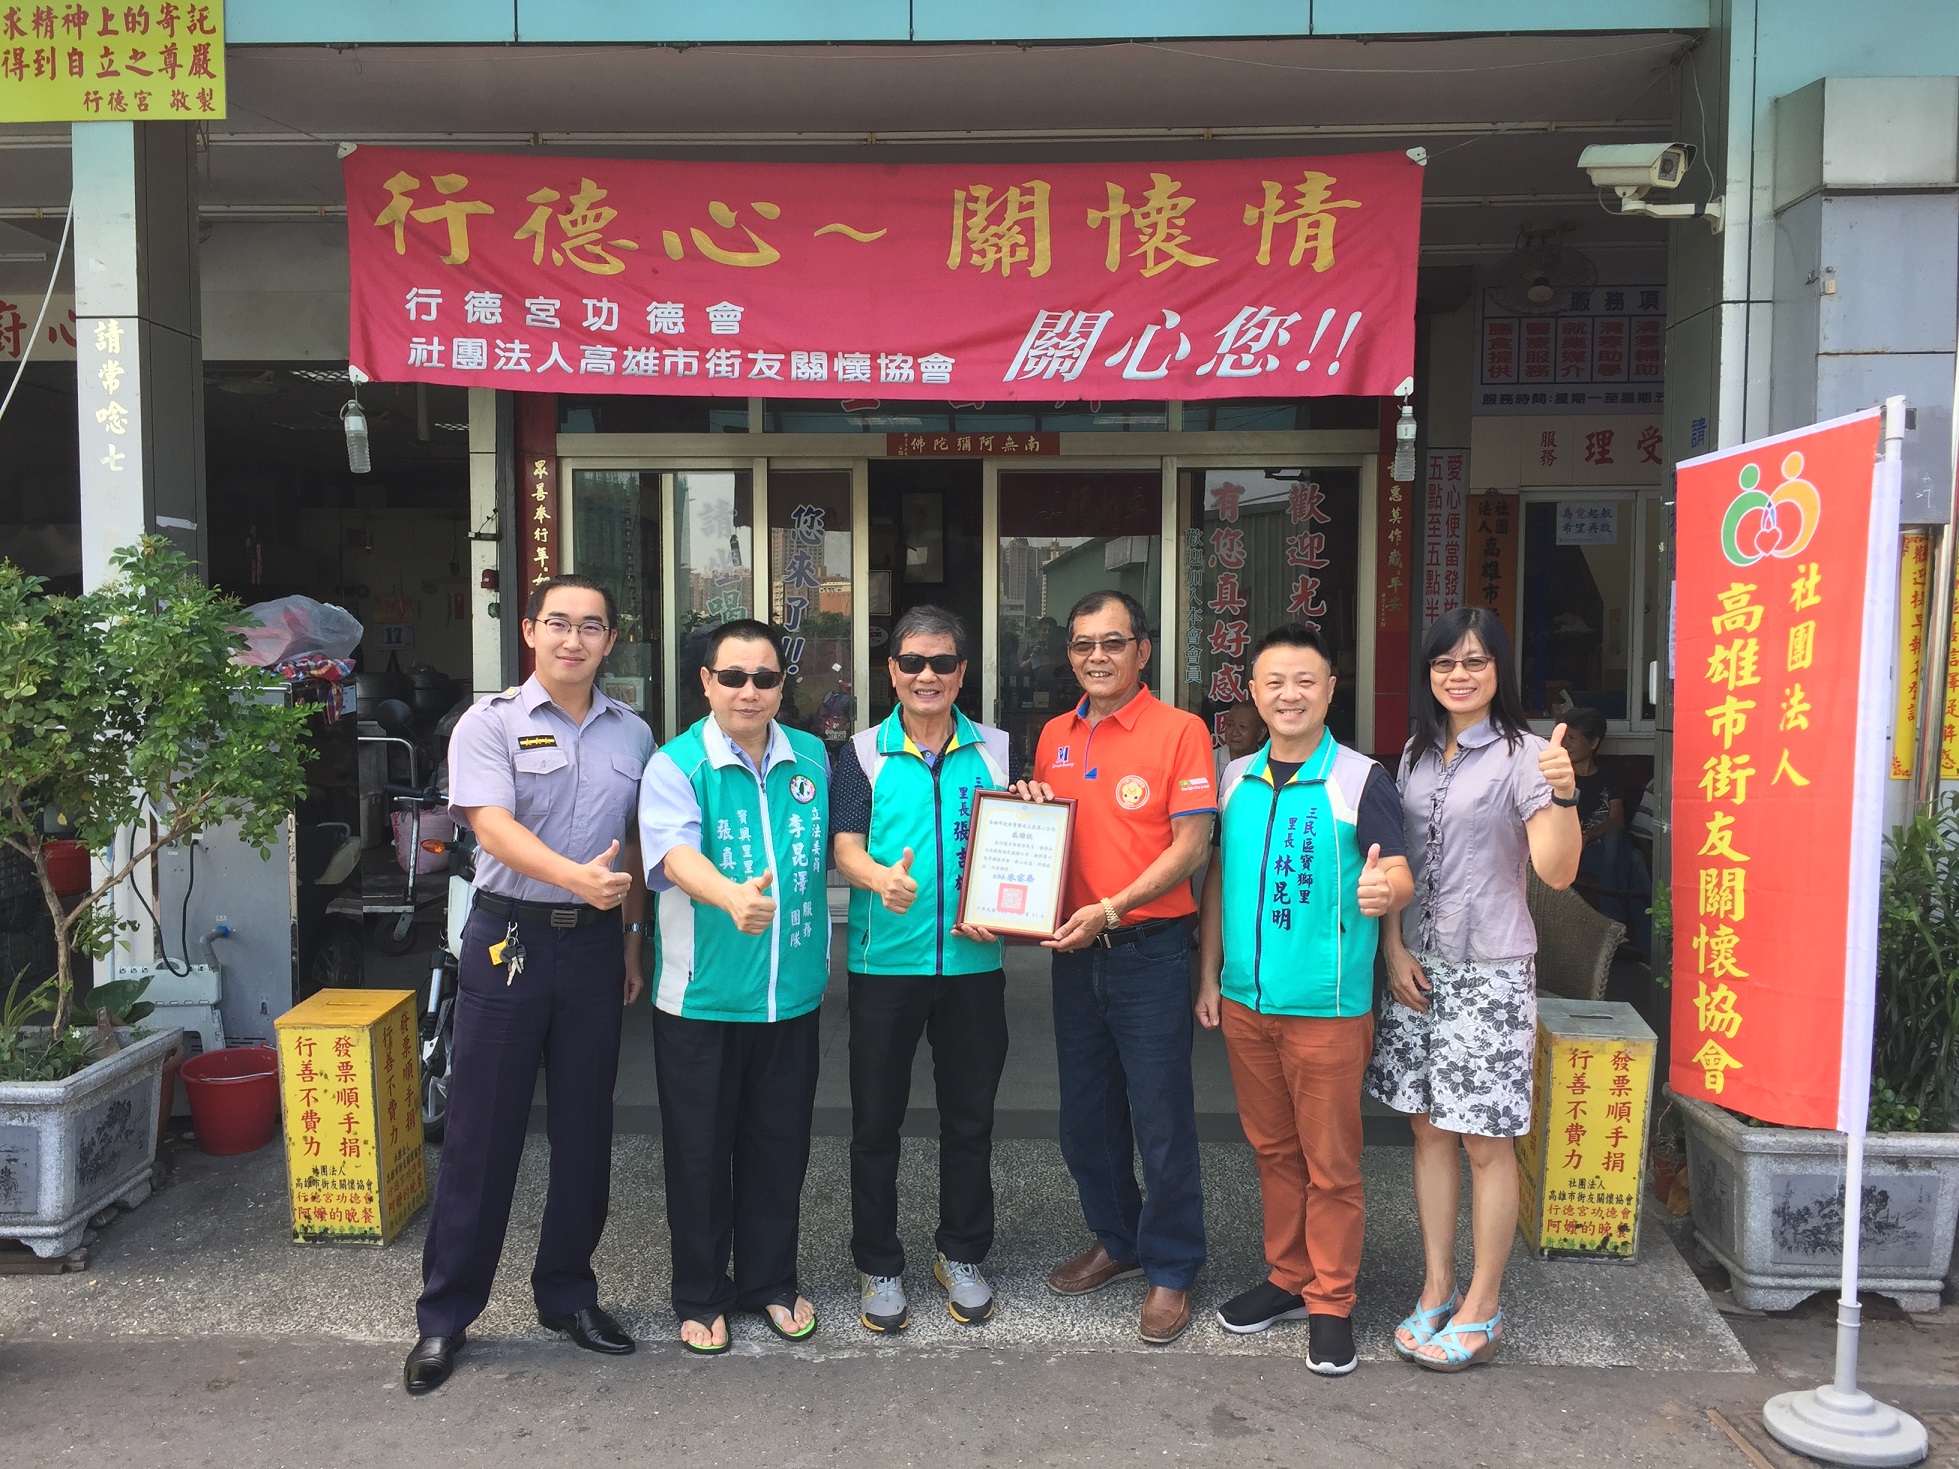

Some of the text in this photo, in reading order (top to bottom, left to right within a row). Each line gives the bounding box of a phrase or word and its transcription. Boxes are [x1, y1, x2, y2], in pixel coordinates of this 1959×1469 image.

[1, 41, 217, 82] 得到自立之尊嚴
[2, 2, 217, 41] 求精神上的寄託
[83, 87, 217, 113] 行德宮 敬製
[405, 286, 745, 336] 行德宮功德會
[93, 318, 128, 472] 請常唸七
[407, 336, 956, 385] 社團法人高雄市街友關懷協會
[1285, 481, 1332, 632] 歡迎光
[1425, 455, 1444, 625] 五點至五點半
[1481, 536, 1501, 618] 高雄市
[1770, 561, 1823, 788] 社團法人
[716, 818, 738, 885] 張真
[736, 808, 754, 882] 寶興里里
[787, 813, 809, 896] 李昆澤
[810, 806, 823, 874] 立法委員
[1296, 807, 1319, 904] 三民區寶獅里
[1691, 582, 1766, 1096] 高雄市街友關懷協會
[294, 1034, 322, 1157] 行善不費力
[331, 1034, 361, 1158] 發票順手捐
[382, 1026, 399, 1148] 行善不費力
[400, 1010, 416, 1133] 發票順手捐
[1561, 1047, 1594, 1170] 行善不費力
[1601, 1048, 1637, 1173] 發票順手捐
[1547, 1203, 1633, 1220] 行德宮功德會
[1548, 1190, 1634, 1206] 高雄市街友關懷協會
[1568, 1177, 1606, 1190] 社團法人
